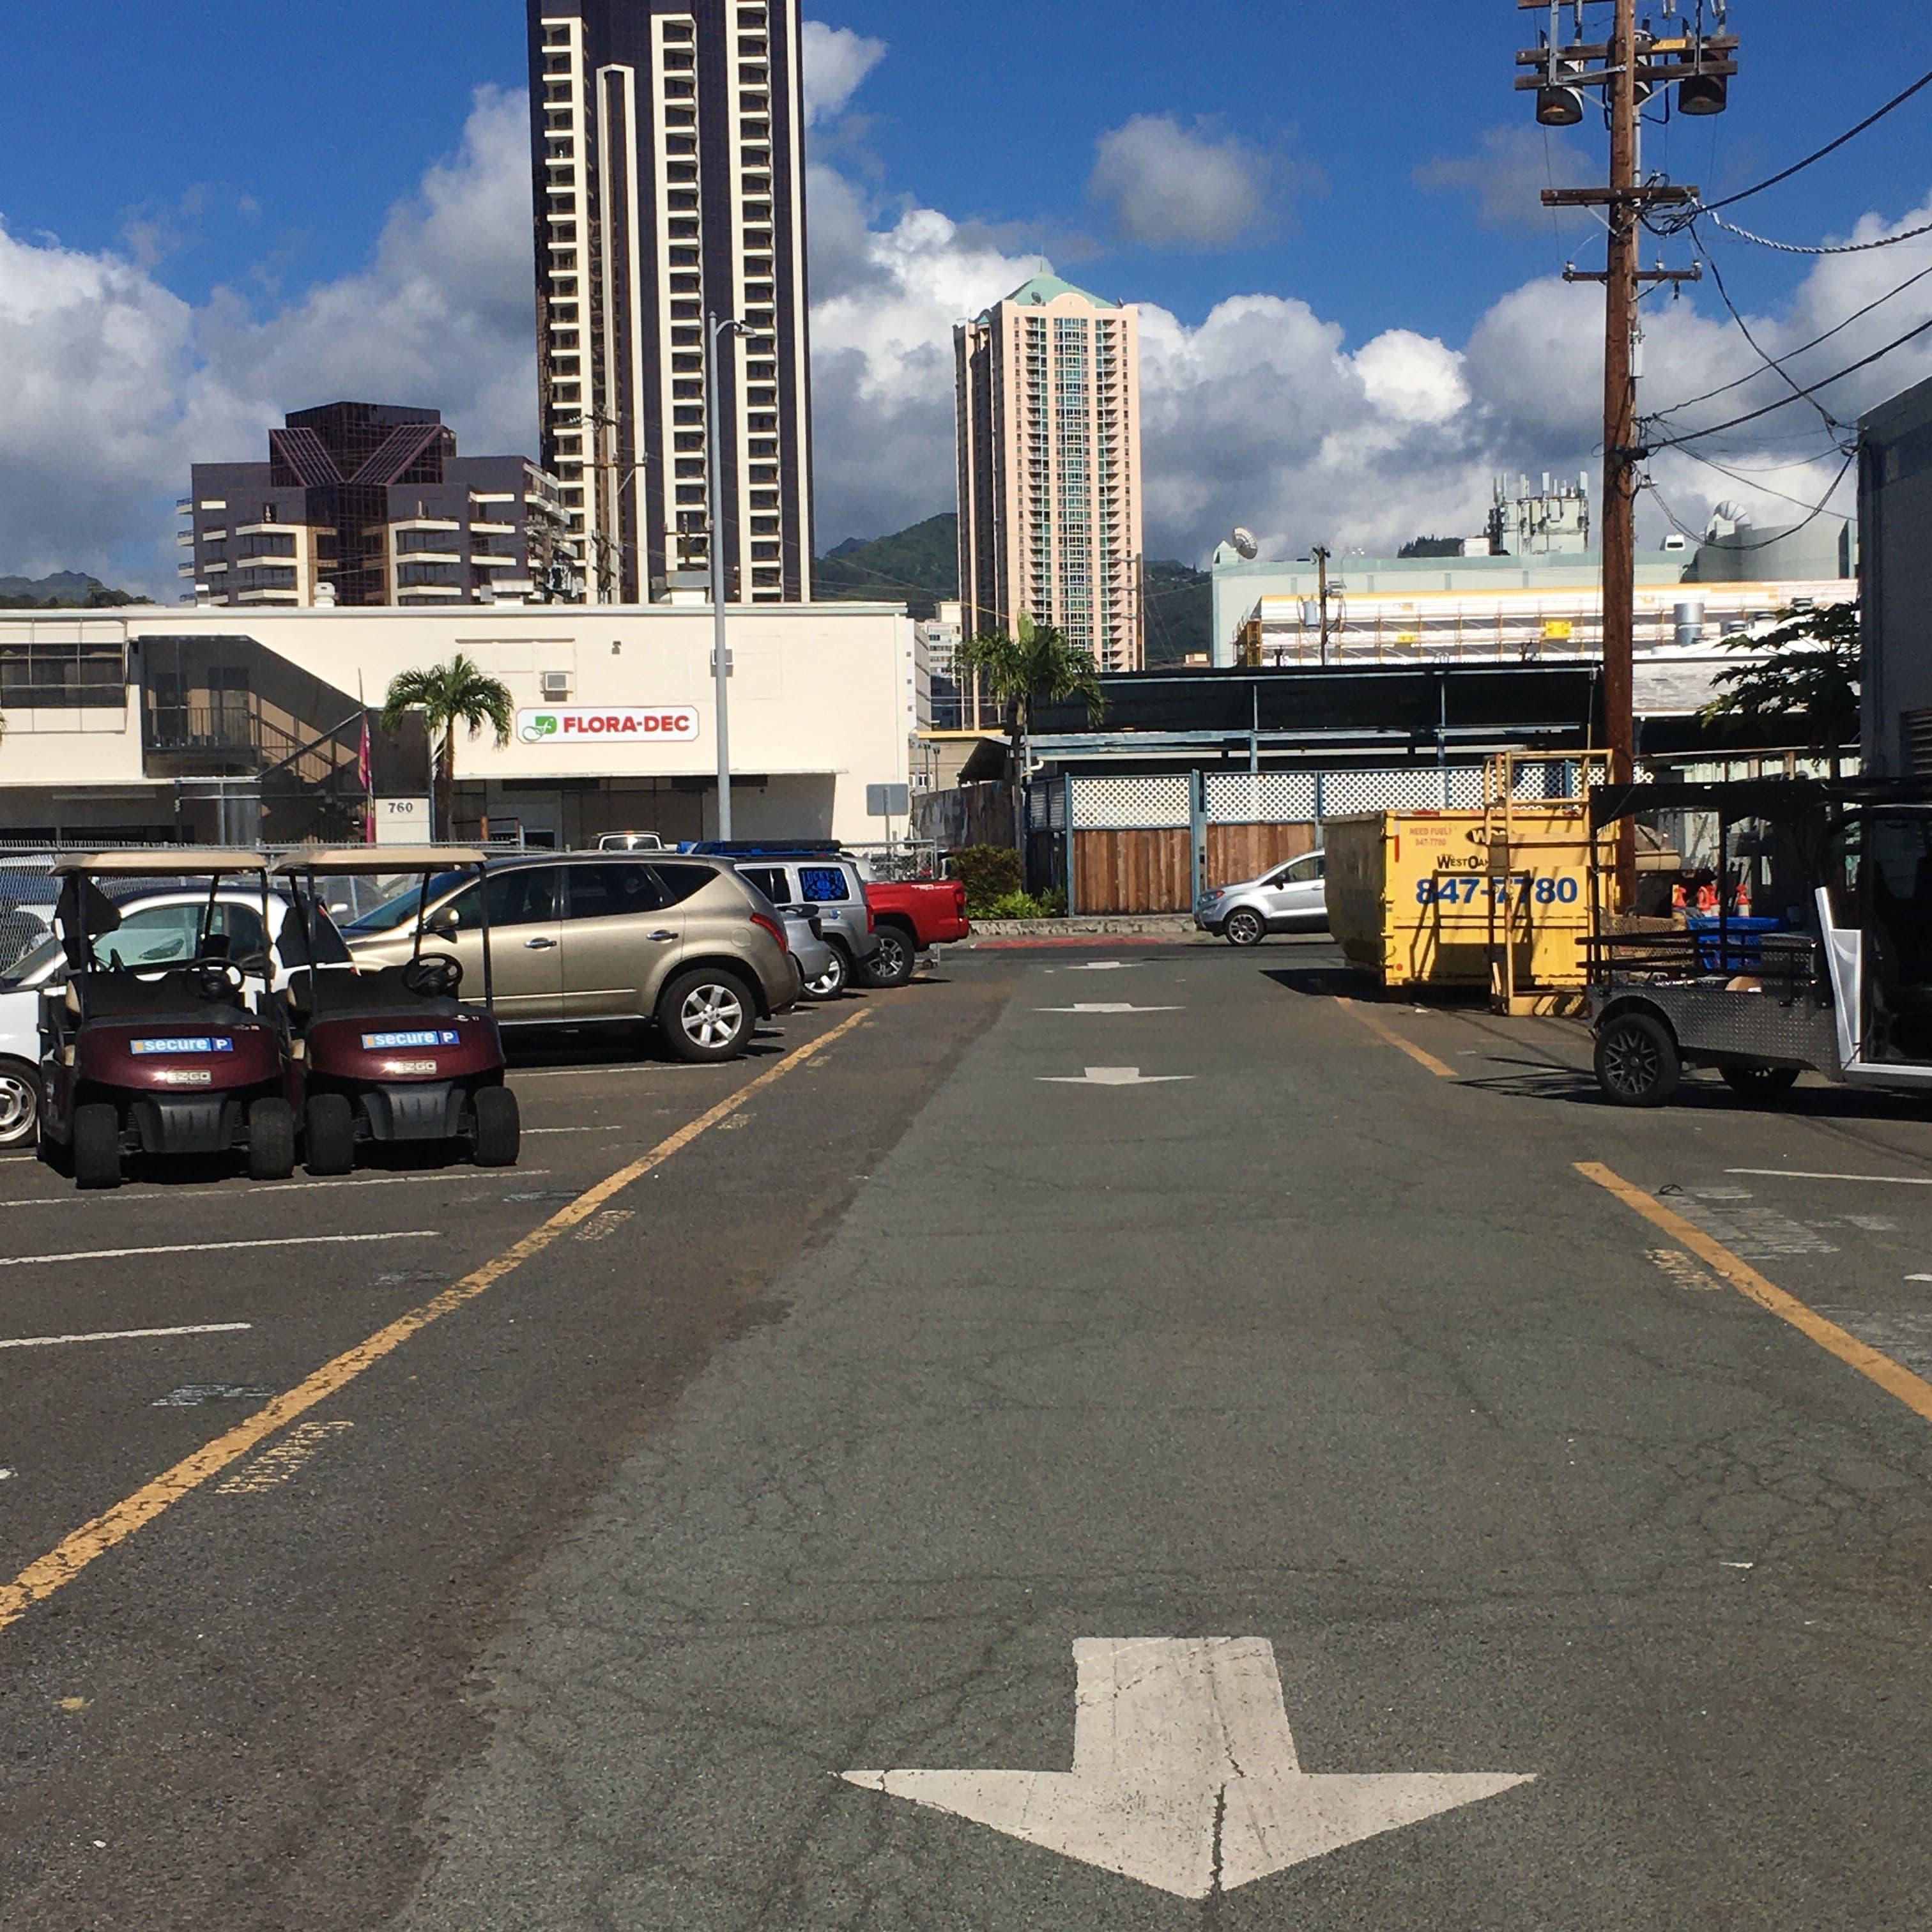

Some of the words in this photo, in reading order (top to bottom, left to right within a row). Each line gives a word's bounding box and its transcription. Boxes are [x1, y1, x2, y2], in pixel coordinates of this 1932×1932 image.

[563, 715, 690, 733] FLORA-DEC
[388, 802, 413, 813] 760
[1416, 877, 1577, 904] 847-7780
[144, 1038, 208, 1051] secure
[376, 1031, 435, 1045] secure
